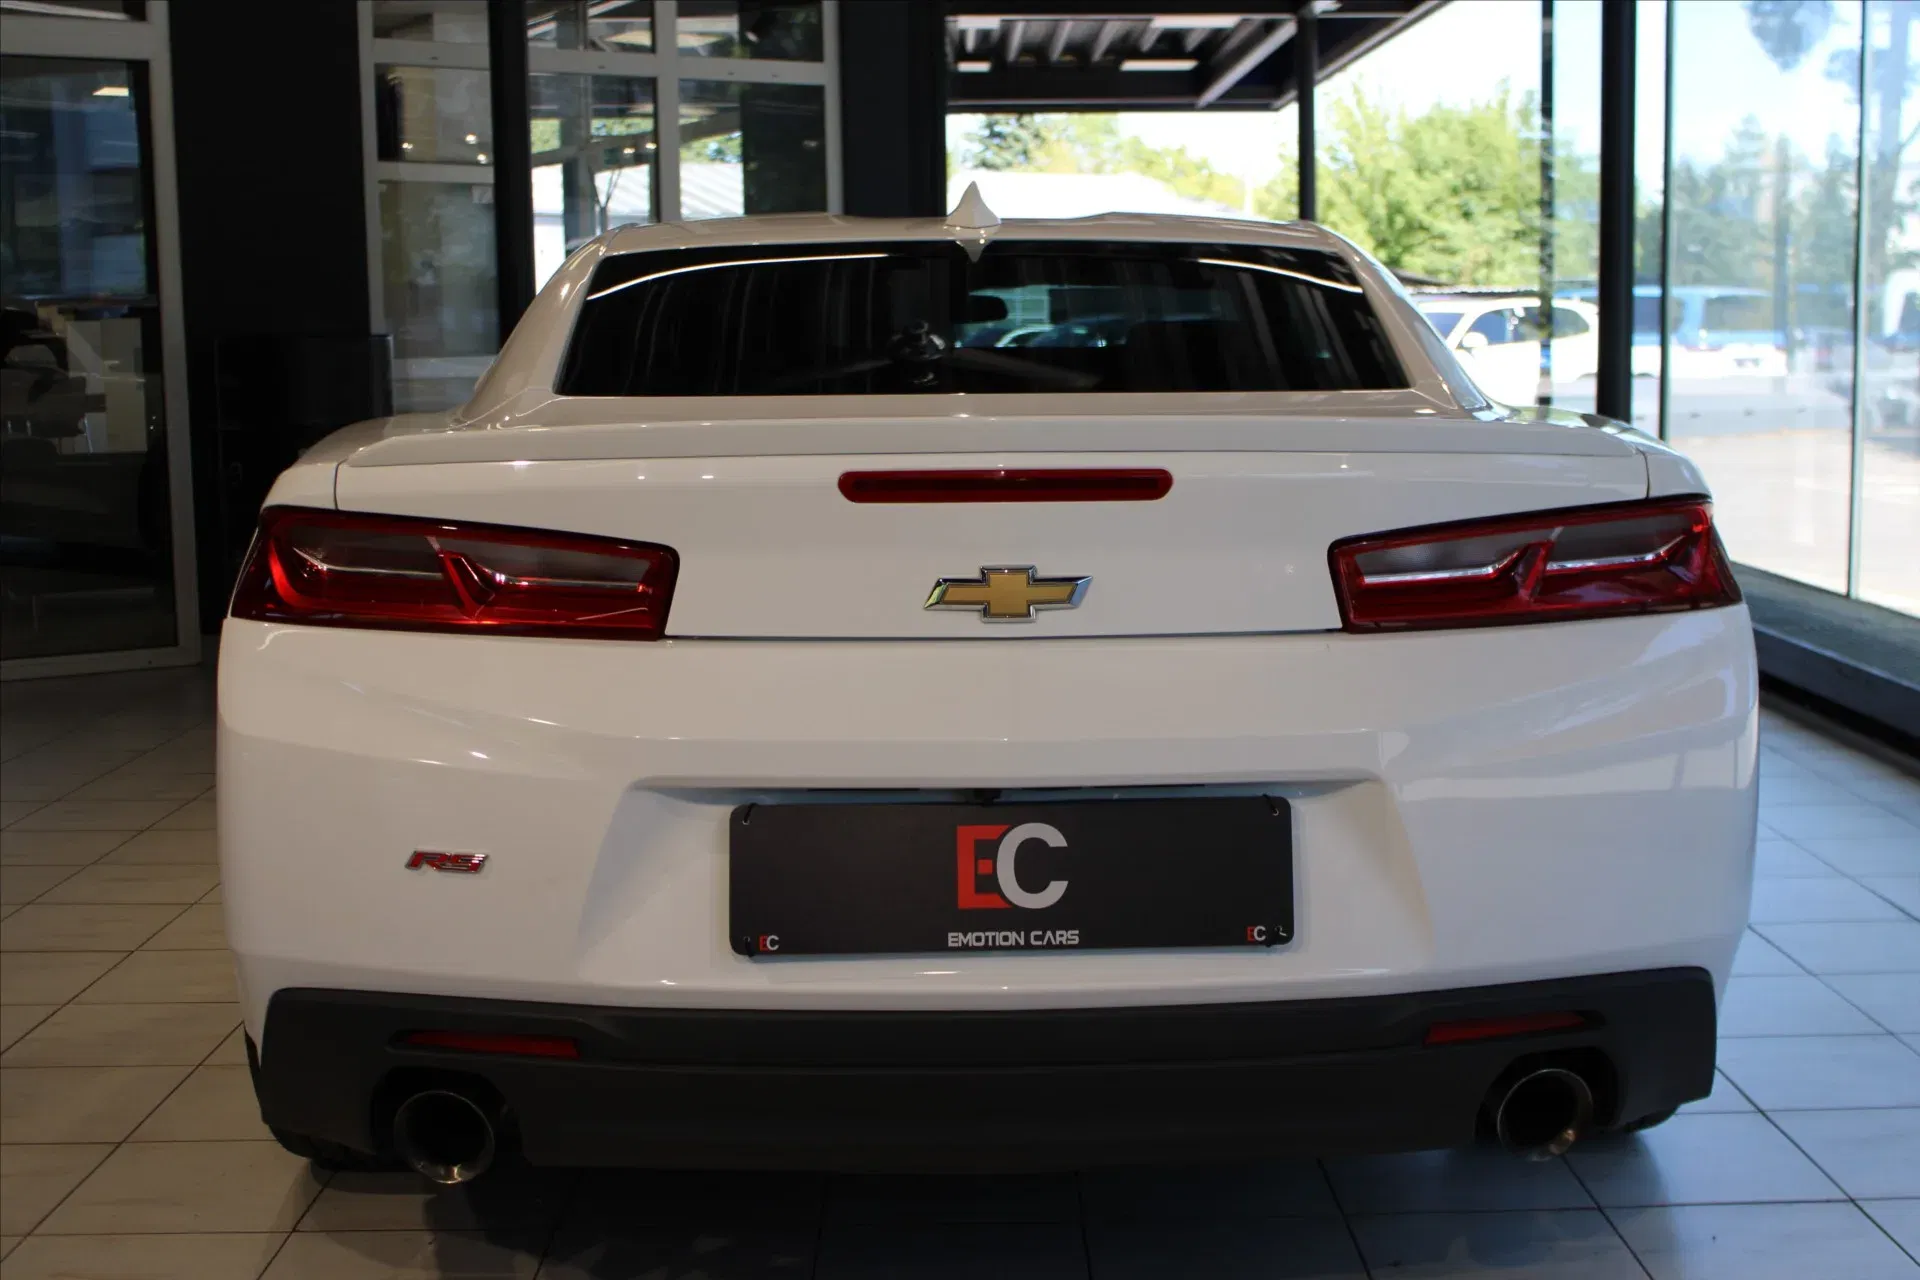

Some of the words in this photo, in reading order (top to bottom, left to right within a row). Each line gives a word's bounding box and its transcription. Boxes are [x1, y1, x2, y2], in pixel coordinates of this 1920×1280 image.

[405, 850, 488, 874] RS
[957, 822, 1069, 910] EC
[947, 931, 1025, 947] EMOTION
[1030, 930, 1080, 946] CARS
[1247, 925, 1266, 941] EC
[759, 934, 780, 951] EC
